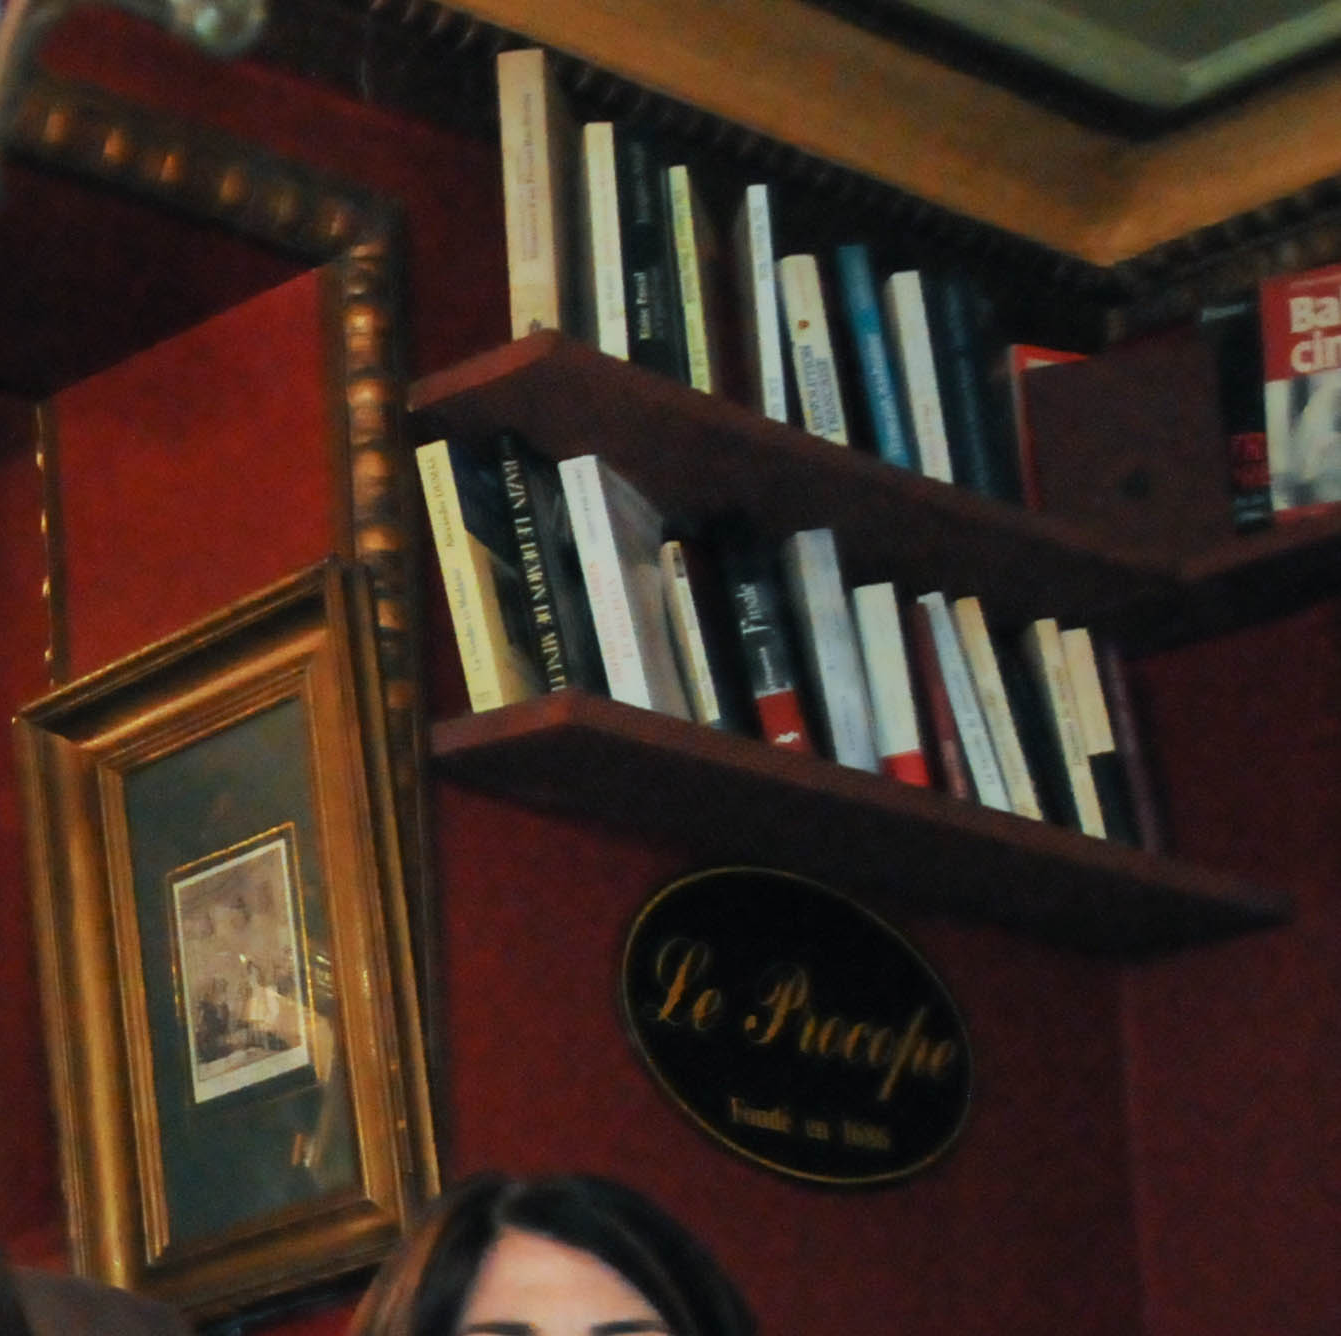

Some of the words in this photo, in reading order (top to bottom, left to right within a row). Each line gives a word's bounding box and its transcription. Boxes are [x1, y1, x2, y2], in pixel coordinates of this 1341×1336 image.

[1290, 290, 1341, 333] Ba
[502, 458, 527, 509] BAZIN
[514, 516, 535, 538] LE
[533, 603, 554, 626] DE
[648, 937, 723, 1031] Le
[744, 964, 956, 1101] Procope
